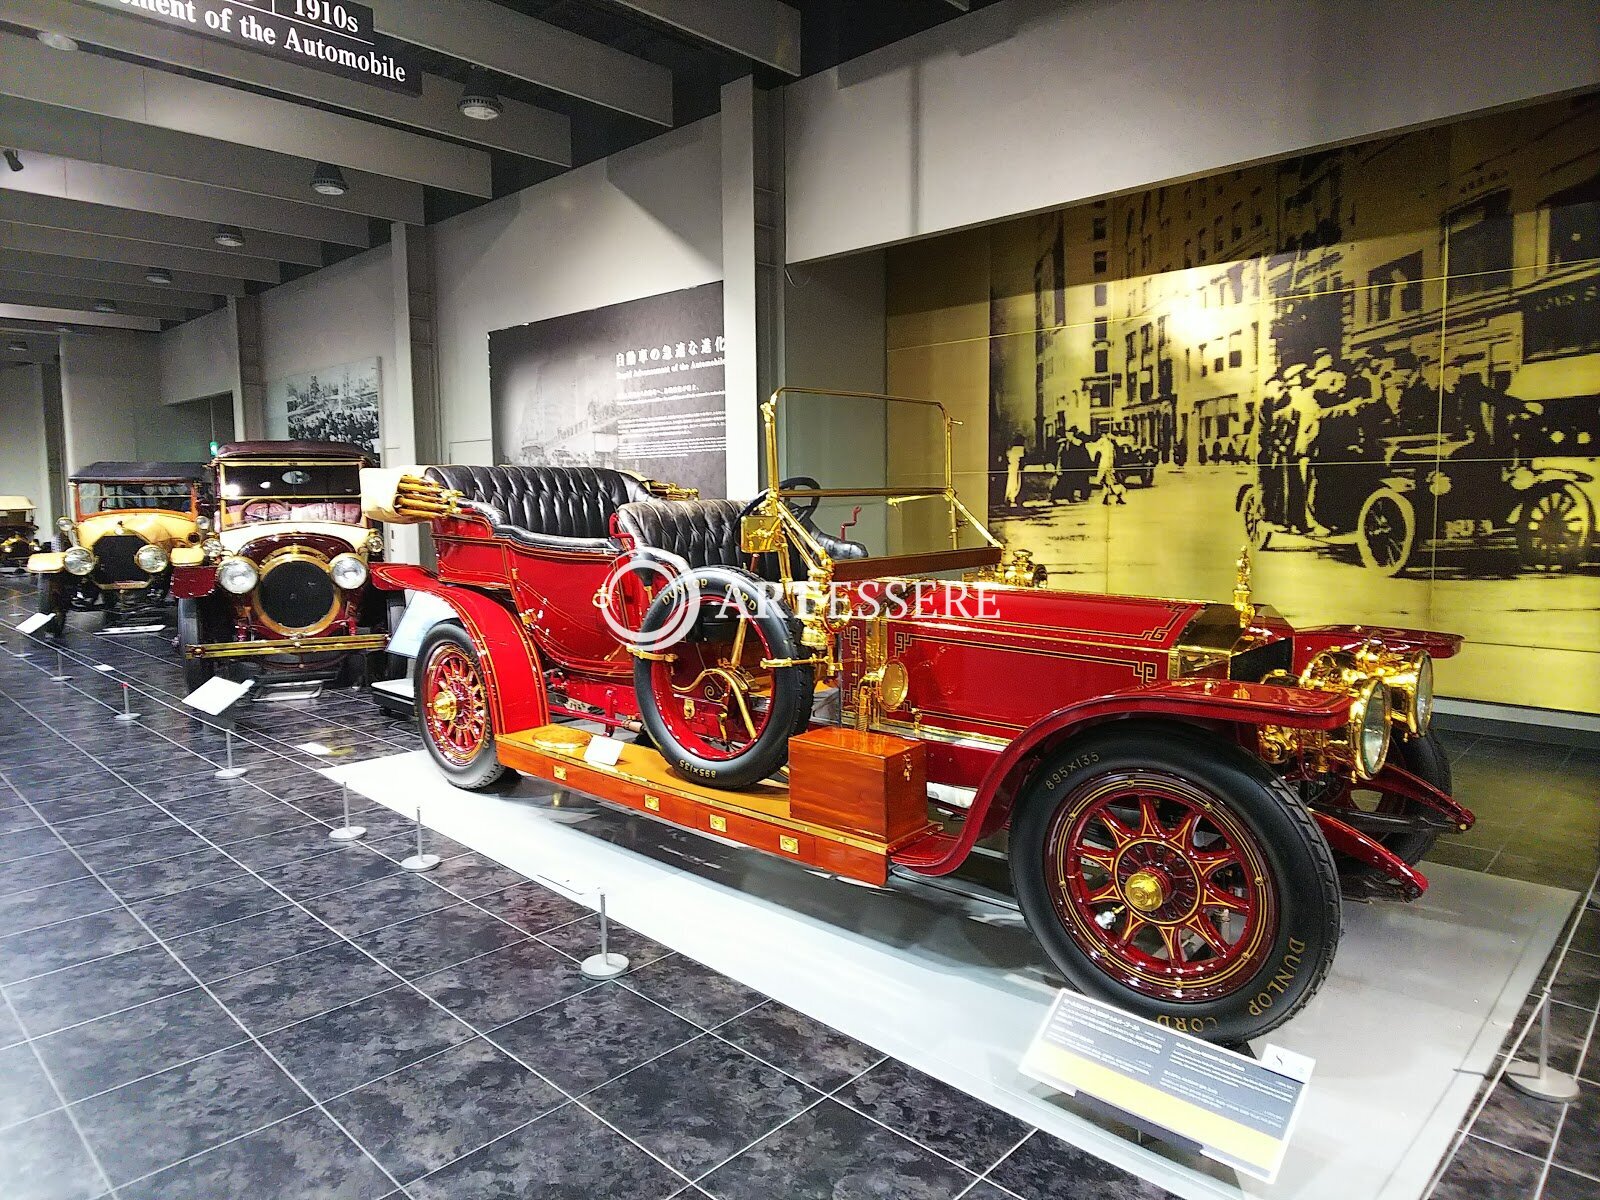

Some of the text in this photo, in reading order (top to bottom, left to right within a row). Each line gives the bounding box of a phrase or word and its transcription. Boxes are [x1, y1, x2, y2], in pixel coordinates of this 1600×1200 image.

[119, 0, 406, 82] ment of the Automobile
[293, 0, 359, 32] 1910s
[1249, 936, 1306, 1017] DUNLOP
